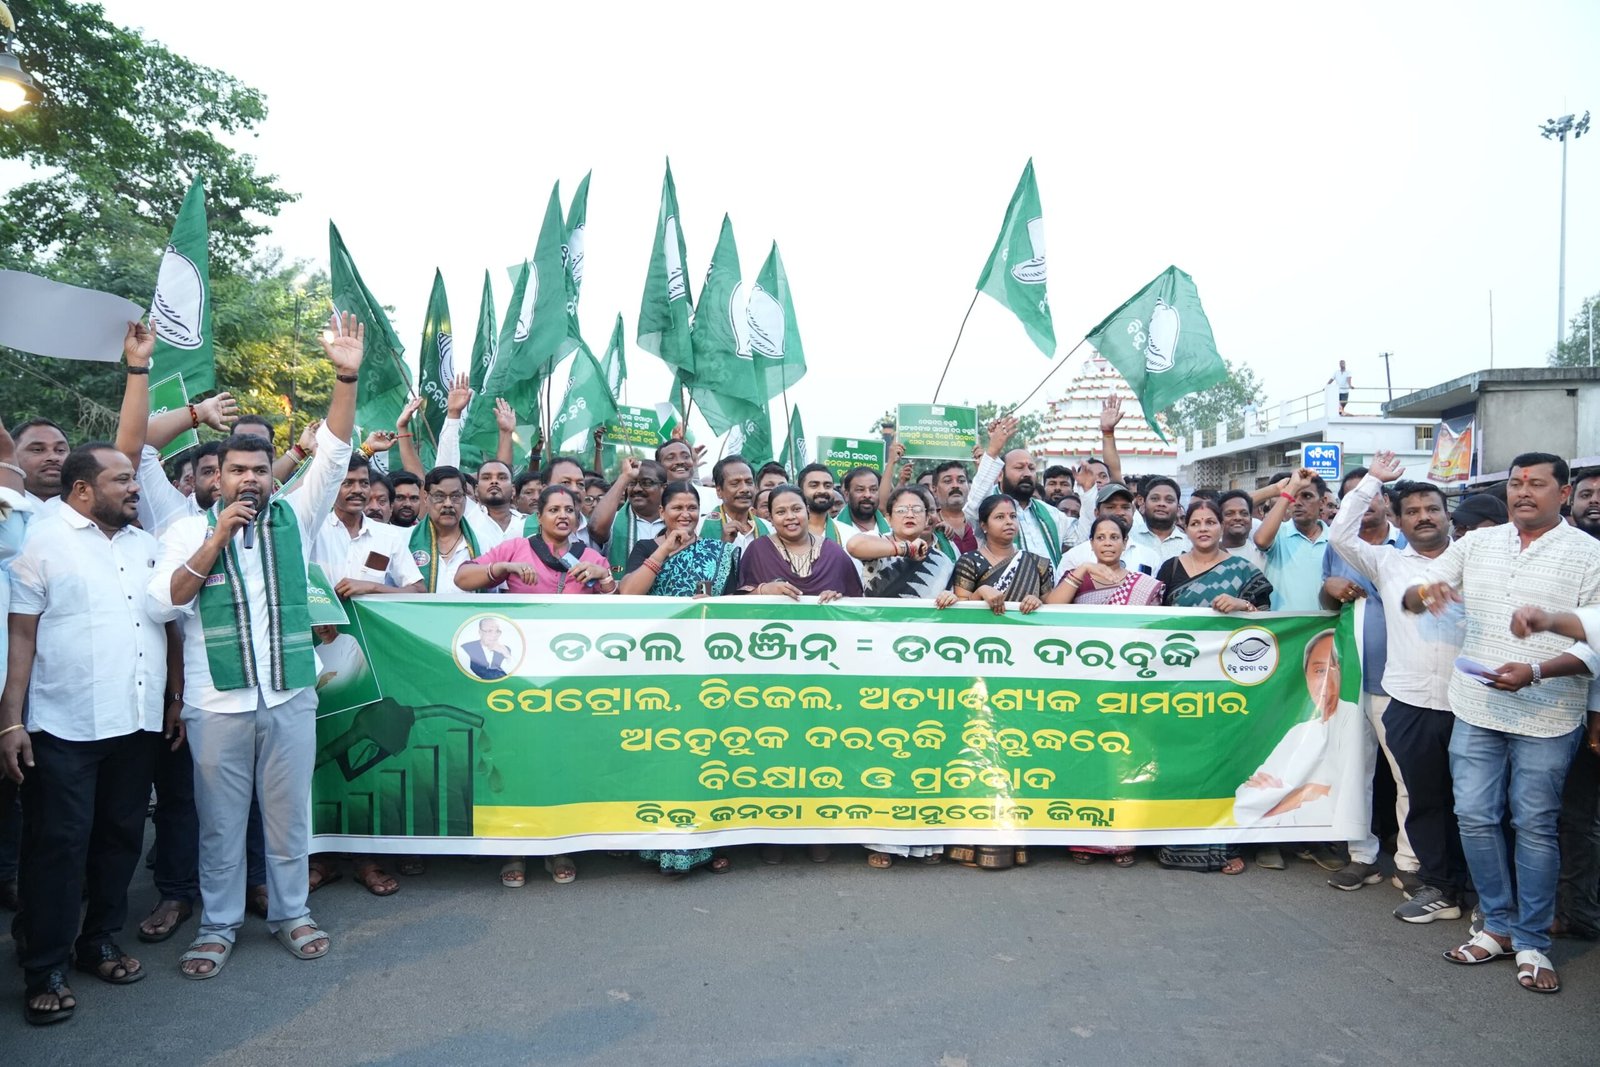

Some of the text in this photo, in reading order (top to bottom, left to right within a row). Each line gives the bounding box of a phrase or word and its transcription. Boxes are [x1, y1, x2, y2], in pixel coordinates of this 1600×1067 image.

[550, 632, 685, 662] ଡବଲ
[892, 635, 1014, 666] ଡବଲ
[1034, 633, 1200, 678] ଦରବୃଦ୍ଧି
[859, 688, 1081, 712] ଅତ୍ୟାବଶ୍ୟକ
[1097, 691, 1249, 718] ସାମଗ୍ରୀର
[620, 720, 1132, 758] ଅହେତୁକ ଦରବୃଦ୍ଧି ବିରୁଦ୍ଧରେ
[698, 760, 1056, 794] ବିକ୍ଷୋଭ ଓ ପ୍ରତିବାଦ
[636, 803, 699, 828] ବିଜୁ
[710, 804, 802, 822] ଜନତା
[1047, 801, 1115, 827] ଜିଲ୍ଲା
